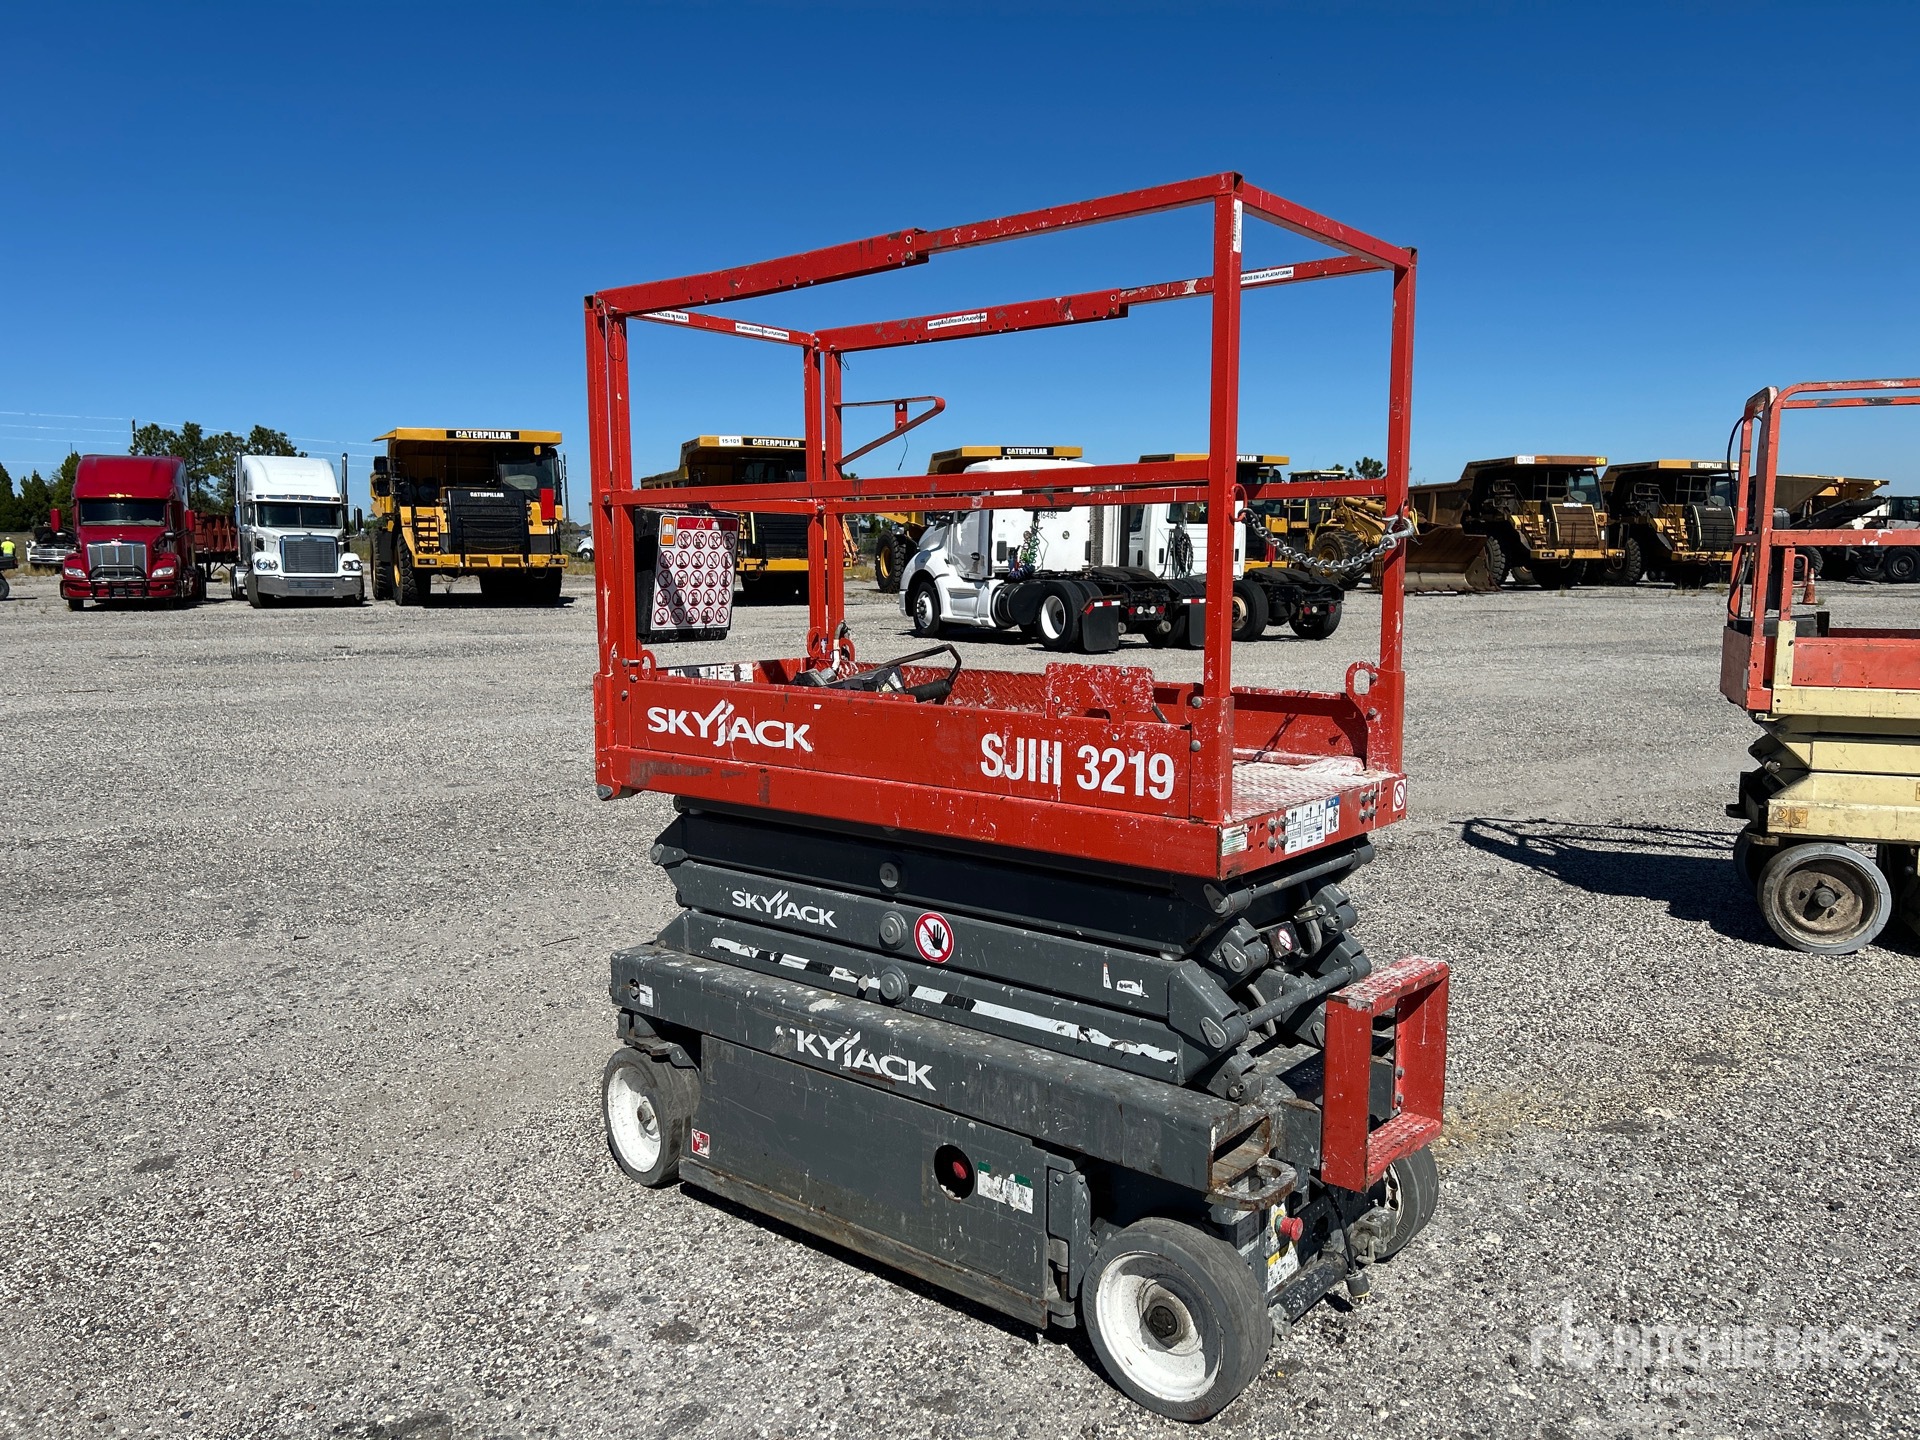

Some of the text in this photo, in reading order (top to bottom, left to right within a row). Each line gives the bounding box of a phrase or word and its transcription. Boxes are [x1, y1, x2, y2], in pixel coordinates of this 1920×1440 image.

[456, 431, 511, 439] CATERPILLAR
[752, 438, 800, 447] CATERPILLAR
[647, 699, 813, 752] SKYJACK
[980, 733, 1174, 800] SJIII 3219
[732, 889, 838, 929] SKYJACK
